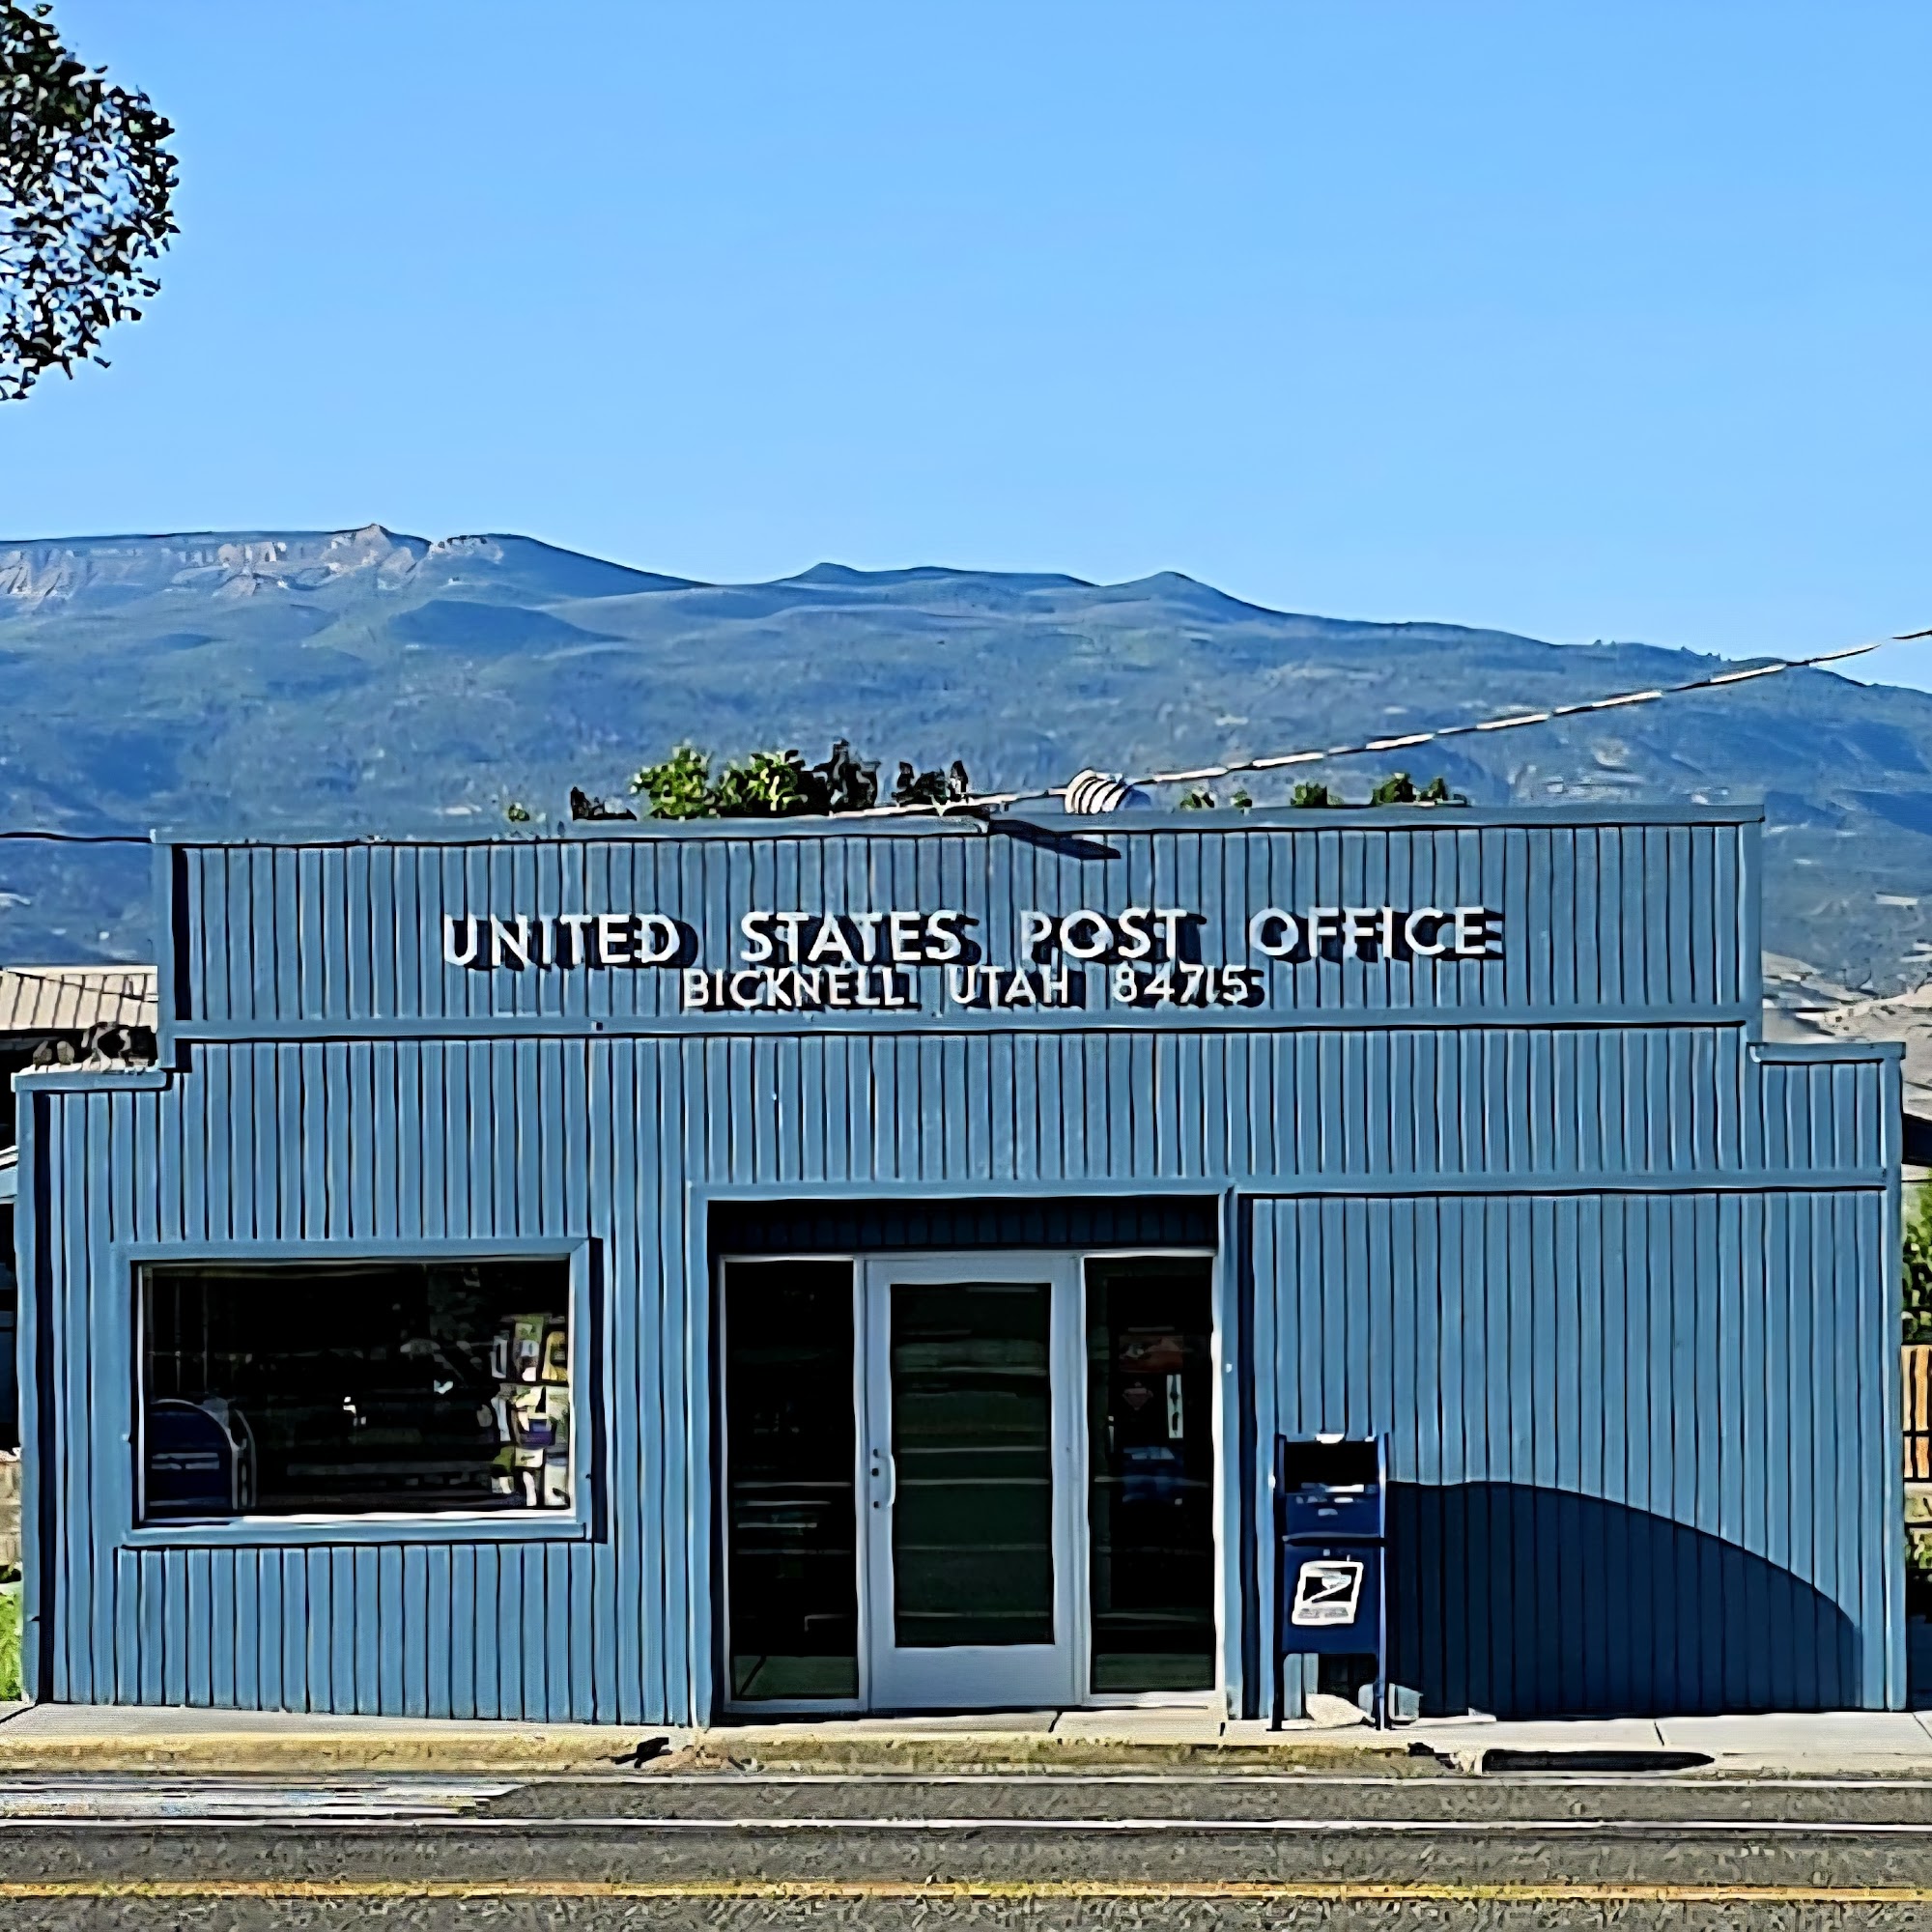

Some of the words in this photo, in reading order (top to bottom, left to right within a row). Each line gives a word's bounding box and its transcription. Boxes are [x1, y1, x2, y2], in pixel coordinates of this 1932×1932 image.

[443, 912, 680, 966] UNITED
[740, 910, 964, 963] STATES
[1020, 907, 1188, 960] POST
[1250, 906, 1486, 959] OFFICE
[684, 967, 906, 1007] BICKNELL
[949, 965, 1068, 1006] UTAH
[1114, 964, 1249, 1006] 84715
